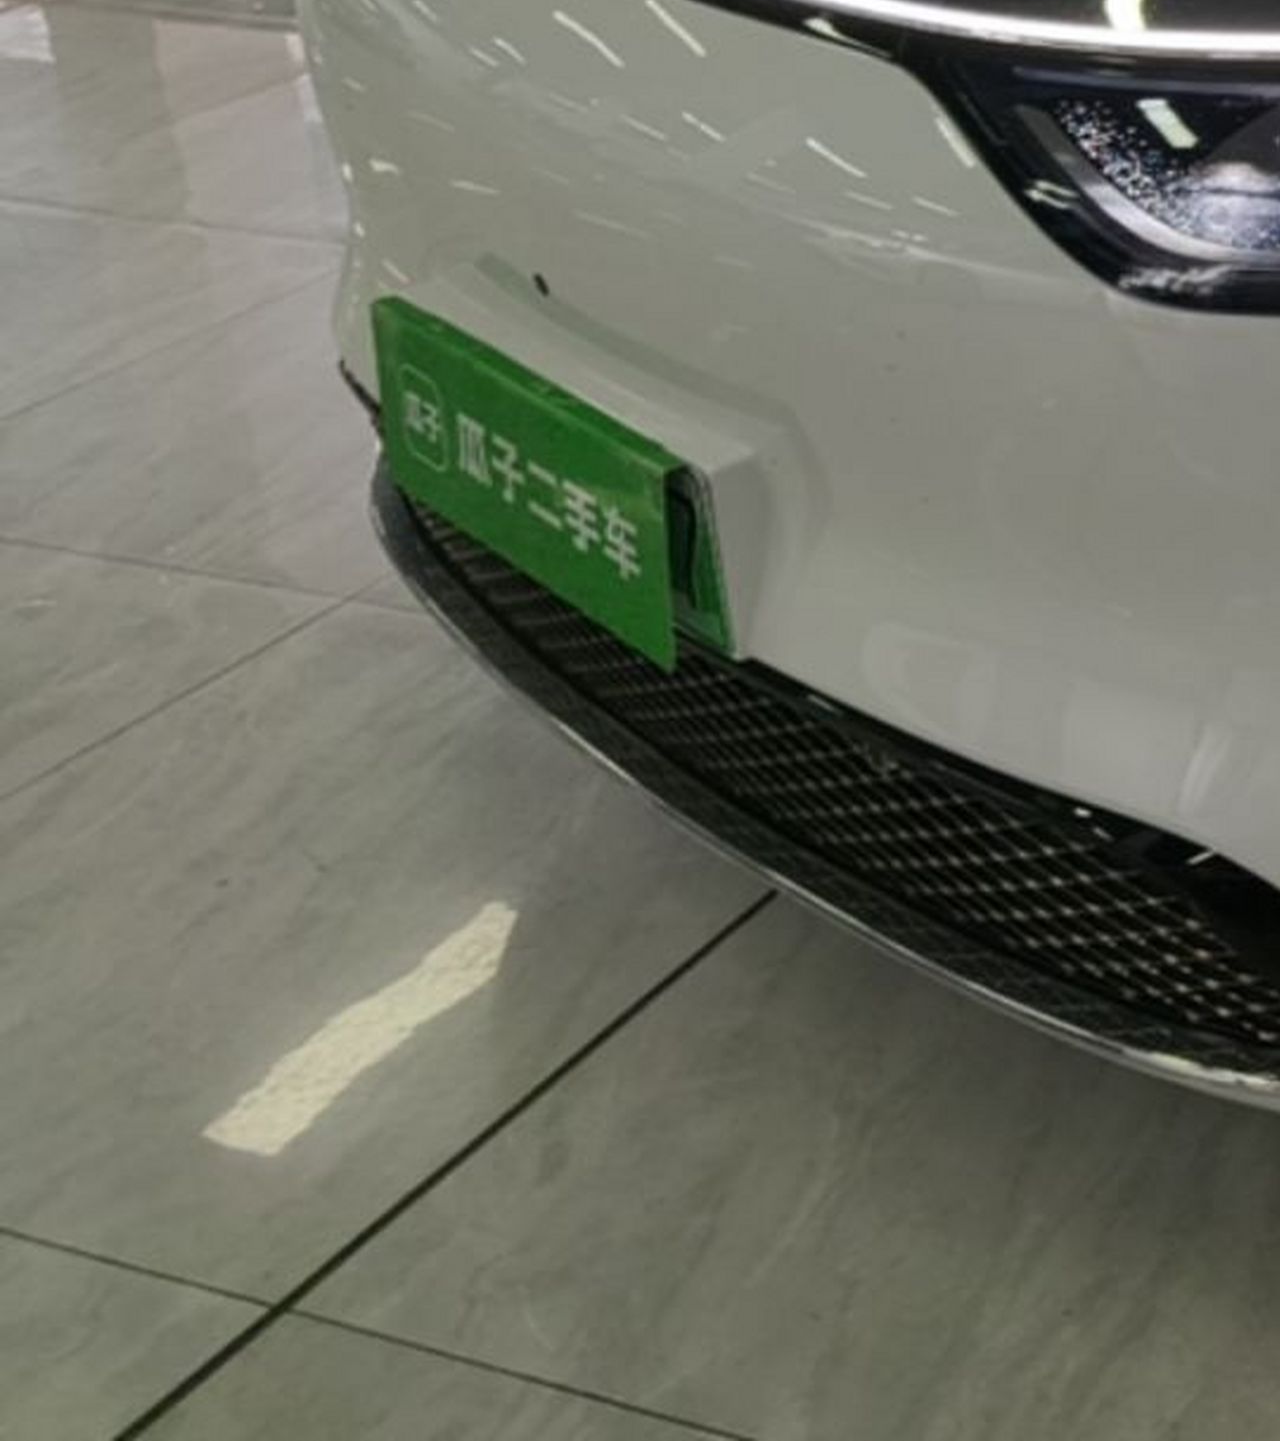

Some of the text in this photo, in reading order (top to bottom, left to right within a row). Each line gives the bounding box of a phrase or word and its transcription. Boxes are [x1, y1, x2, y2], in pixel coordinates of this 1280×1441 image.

[455, 412, 641, 581] 瓜子二手车
